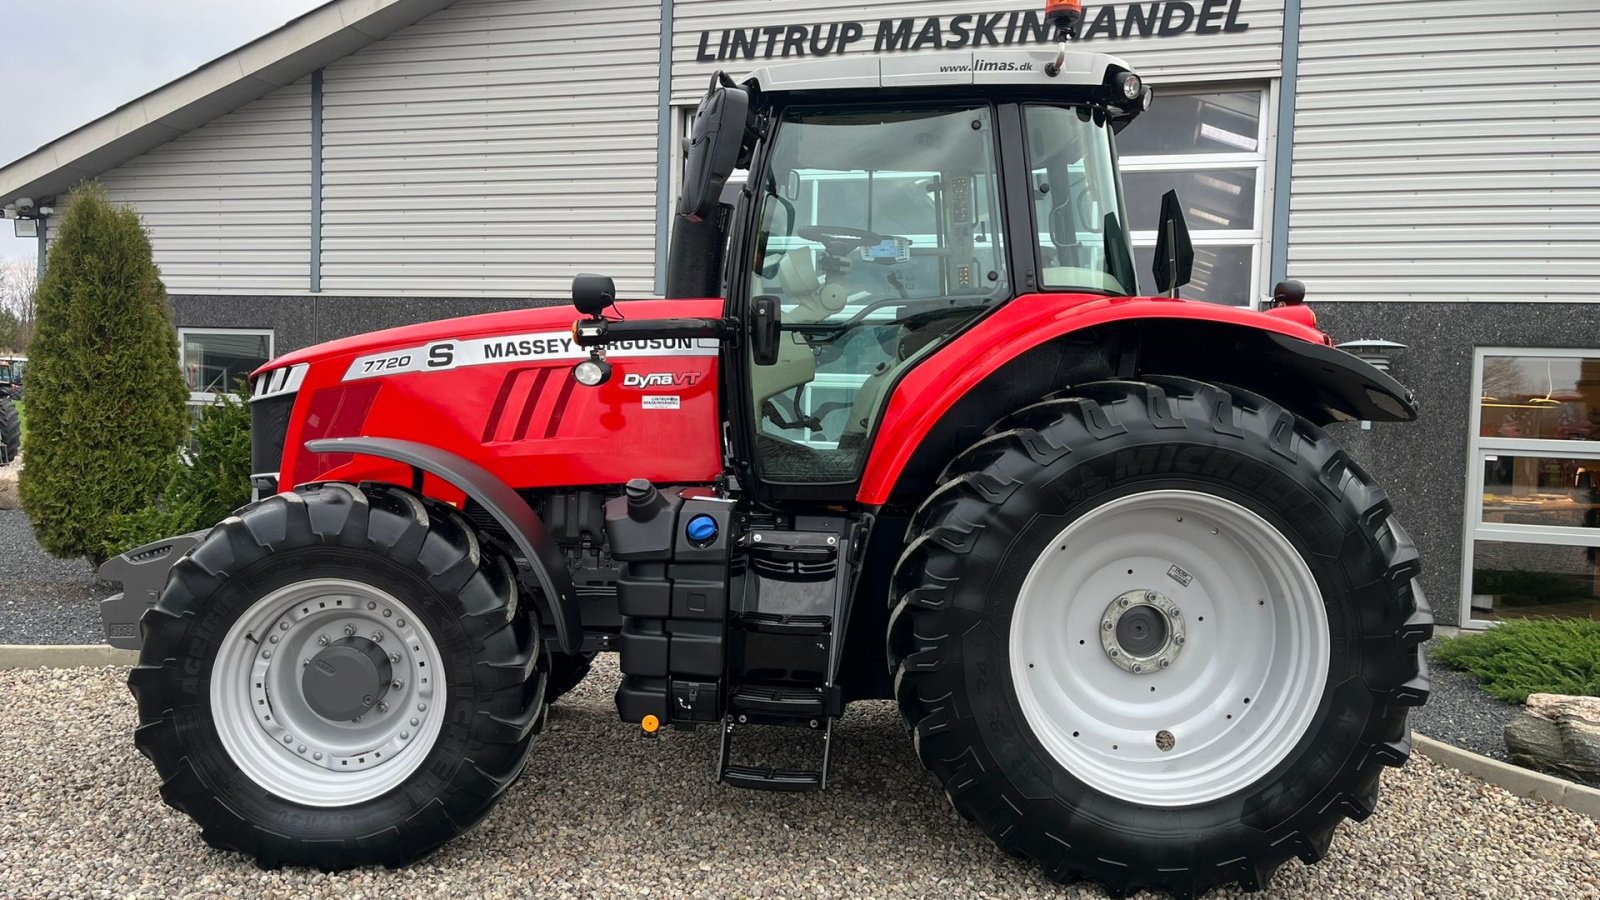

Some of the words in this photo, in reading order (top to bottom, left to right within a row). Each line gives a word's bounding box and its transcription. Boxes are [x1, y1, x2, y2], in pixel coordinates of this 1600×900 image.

[696, 21, 863, 62] LINTRUP
[940, 59, 1033, 73] www.limas.dk
[363, 355, 412, 373] 7720
[427, 343, 455, 368] S
[484, 338, 573, 360] MASSEY
[580, 336, 693, 352] RGUSON
[623, 372, 701, 388] DynaVT
